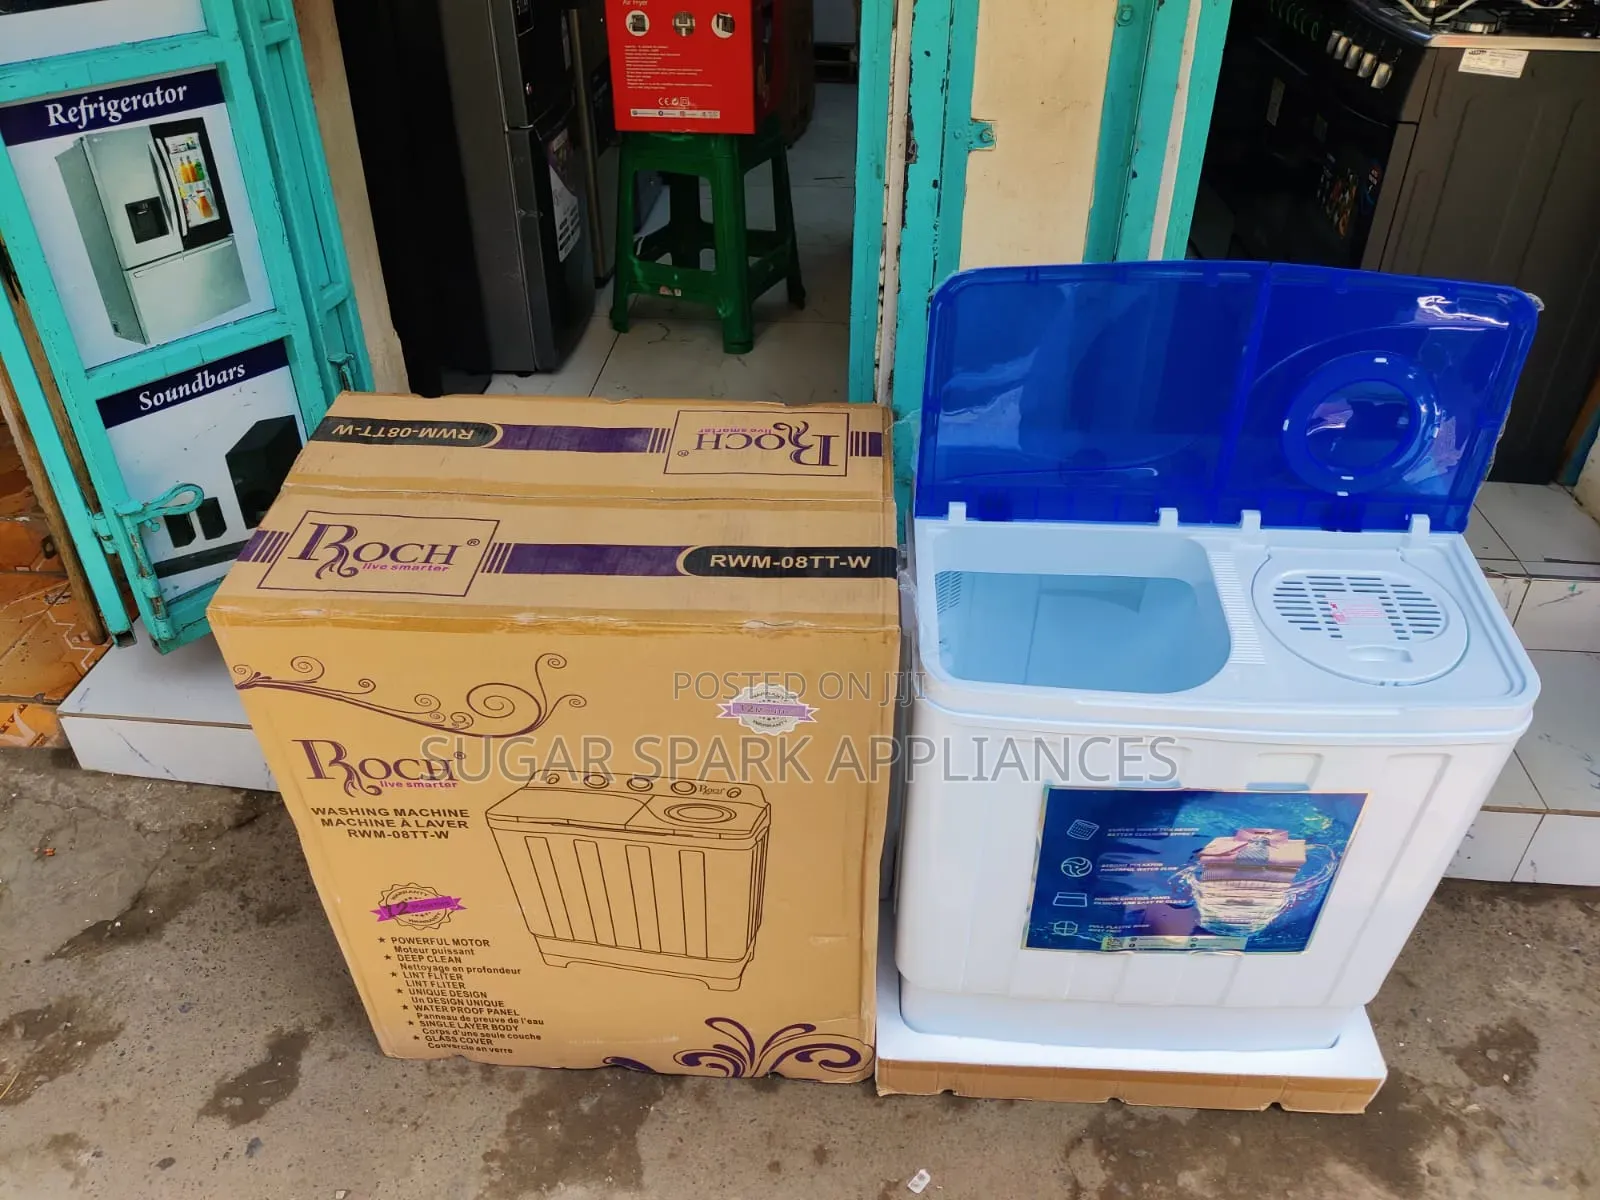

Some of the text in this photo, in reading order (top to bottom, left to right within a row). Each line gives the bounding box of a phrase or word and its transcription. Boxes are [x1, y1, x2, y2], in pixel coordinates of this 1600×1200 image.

[45, 85, 187, 129] Refrigerator
[139, 364, 246, 411] Soundbars
[331, 424, 474, 441] RWM-08TT-W
[697, 427, 746, 435] smarter
[709, 553, 872, 570] RWM-08TT-W
[362, 562, 449, 573] live smarter
[379, 780, 459, 789] live smarter
[311, 807, 470, 818] WASHING MACHINE
[321, 817, 469, 829] MACHINE À LAVER
[348, 829, 450, 839] RWM-08TT-W
[391, 936, 490, 947] POWERFUL MOTOR
[394, 945, 475, 956] Moteur puissant
[397, 954, 462, 964] DEEP CLEAN
[400, 963, 450, 973] Nettoyage
[466, 966, 521, 975] profondeur
[403, 971, 464, 981] LINT FLITER
[430, 981, 466, 989] FLITER
[408, 988, 487, 999] UNIQUE DESIGN
[411, 996, 505, 1007] Un DESIGN UNIQUE
[413, 1004, 520, 1016] WATER PROOF PANEL
[416, 1012, 458, 1021] Panneau
[460, 1014, 471, 1022] de
[521, 1017, 545, 1025] l'eau
[419, 1020, 519, 1032] SINGLE LAYER BODY
[422, 1028, 451, 1036] Corps
[452, 1029, 478, 1037] d'une
[425, 1035, 494, 1046] GLASS COVER
